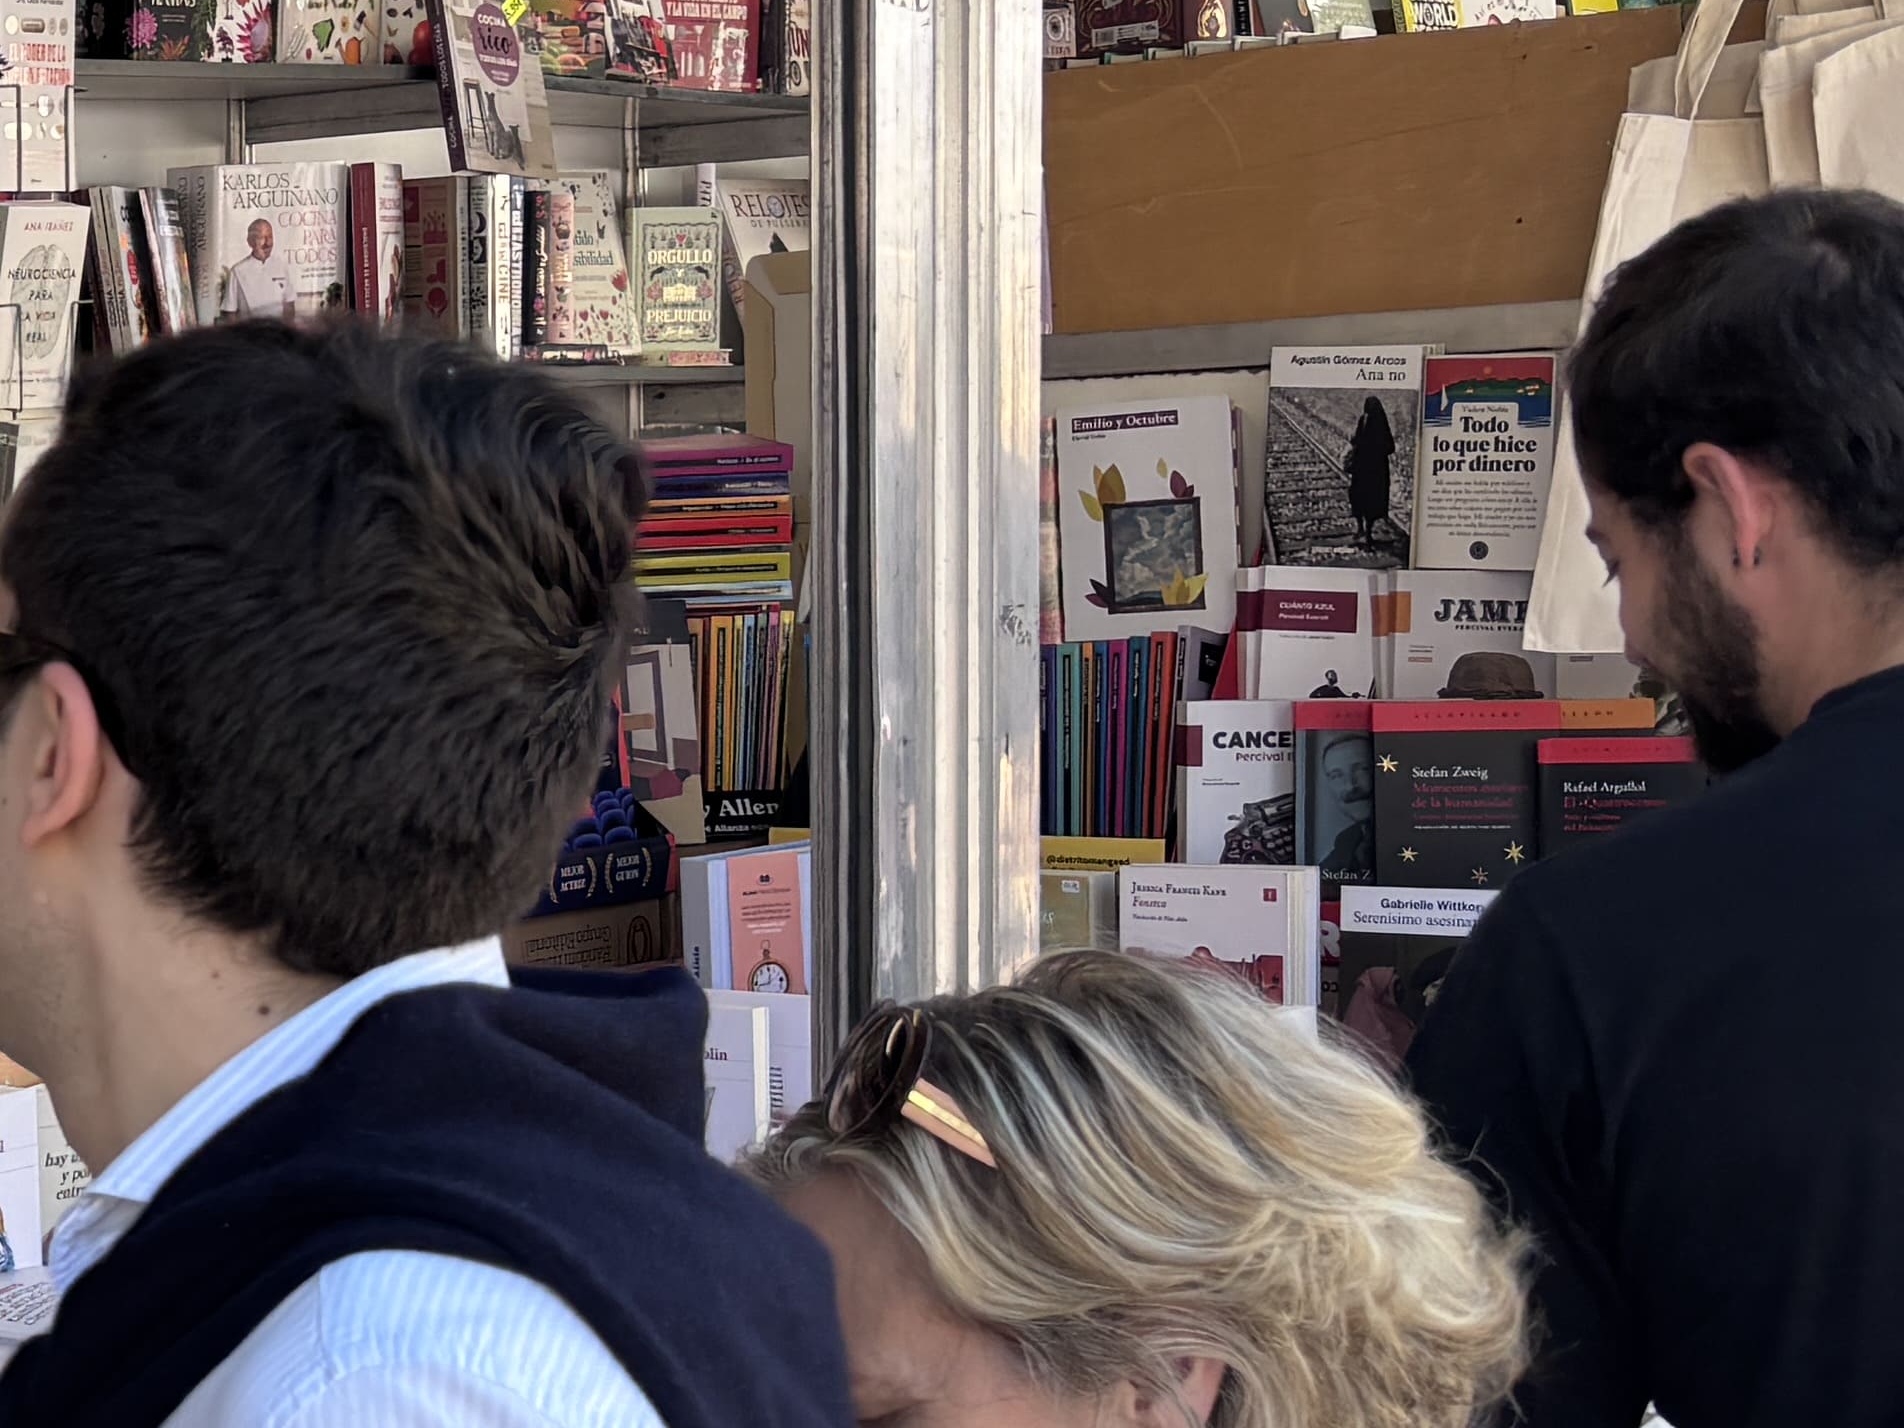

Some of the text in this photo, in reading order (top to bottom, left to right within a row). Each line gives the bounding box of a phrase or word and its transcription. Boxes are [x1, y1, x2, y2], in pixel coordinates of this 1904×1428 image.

[1410, 1, 1458, 28] WORLD
[647, 249, 713, 266] ORGULLO
[646, 308, 712, 325] PREJUICIO
[1072, 412, 1175, 432] Emilio y Octubre
[1460, 416, 1509, 434] Todo
[1432, 435, 1537, 457] lo que hice
[1432, 455, 1535, 476] por dinero
[1412, 765, 1488, 781] Stefan Zweig
